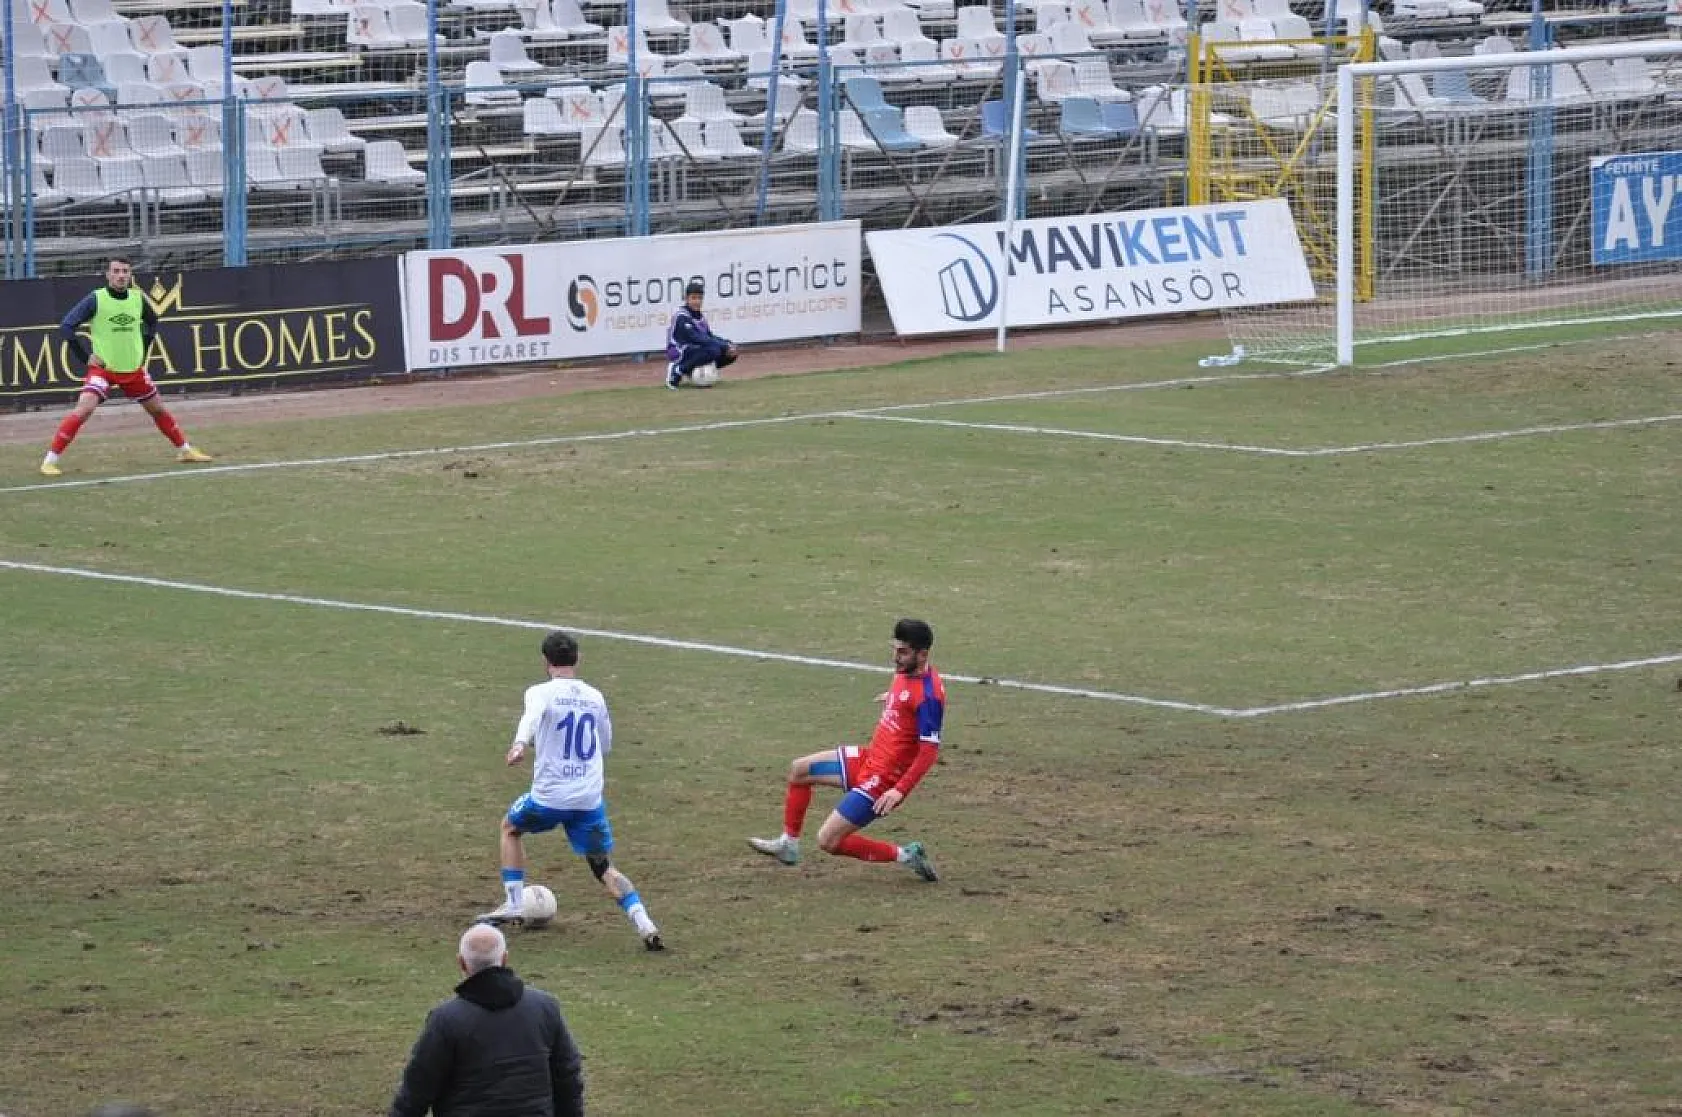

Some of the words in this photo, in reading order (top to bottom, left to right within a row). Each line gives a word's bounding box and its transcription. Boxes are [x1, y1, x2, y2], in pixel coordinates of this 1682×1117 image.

[1604, 173, 1682, 249] AY
[429, 253, 550, 342] DRL
[717, 256, 847, 298] district
[1047, 269, 1245, 315] ASANSÖR
[190, 310, 376, 372] HOMES
[606, 310, 669, 330] natura
[556, 711, 597, 760] 10
